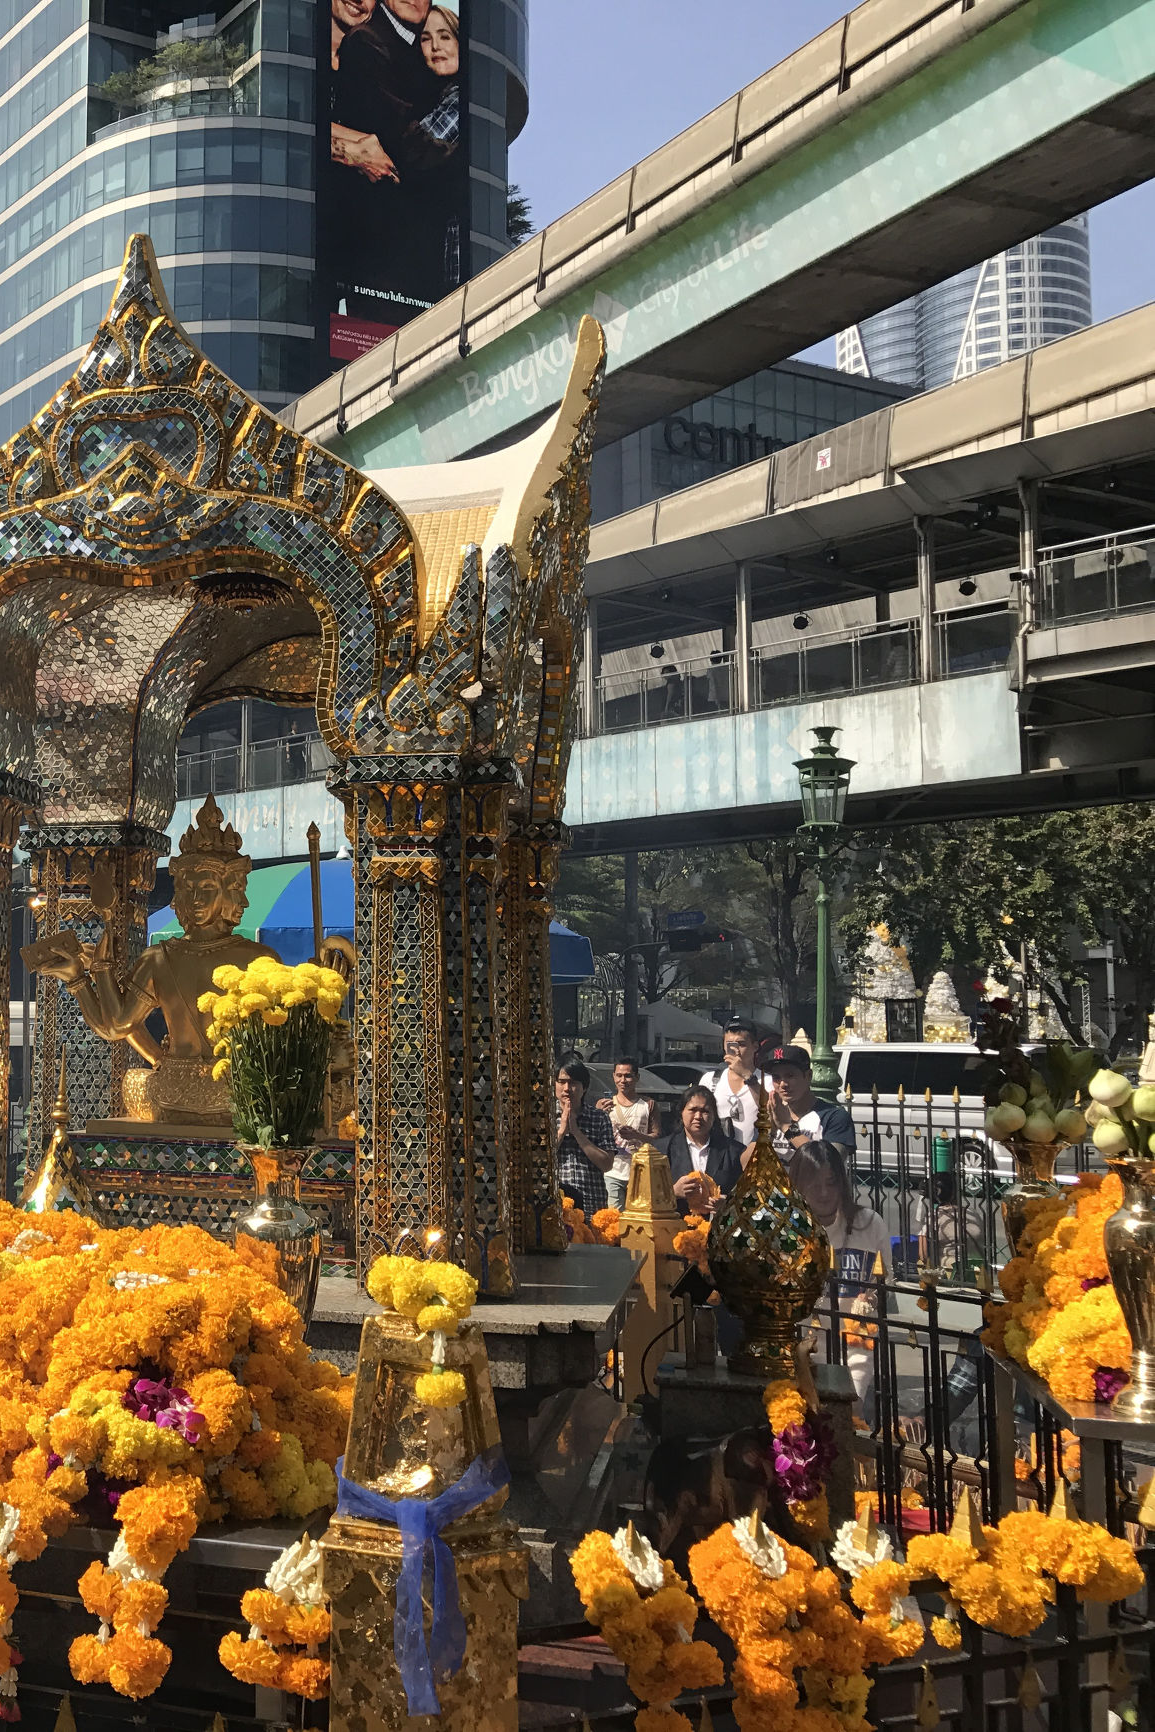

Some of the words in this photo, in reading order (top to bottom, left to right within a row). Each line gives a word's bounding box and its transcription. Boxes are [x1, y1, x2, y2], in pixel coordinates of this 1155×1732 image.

[639, 273, 681, 316] City
[687, 247, 709, 288] of
[714, 221, 768, 272] Life
